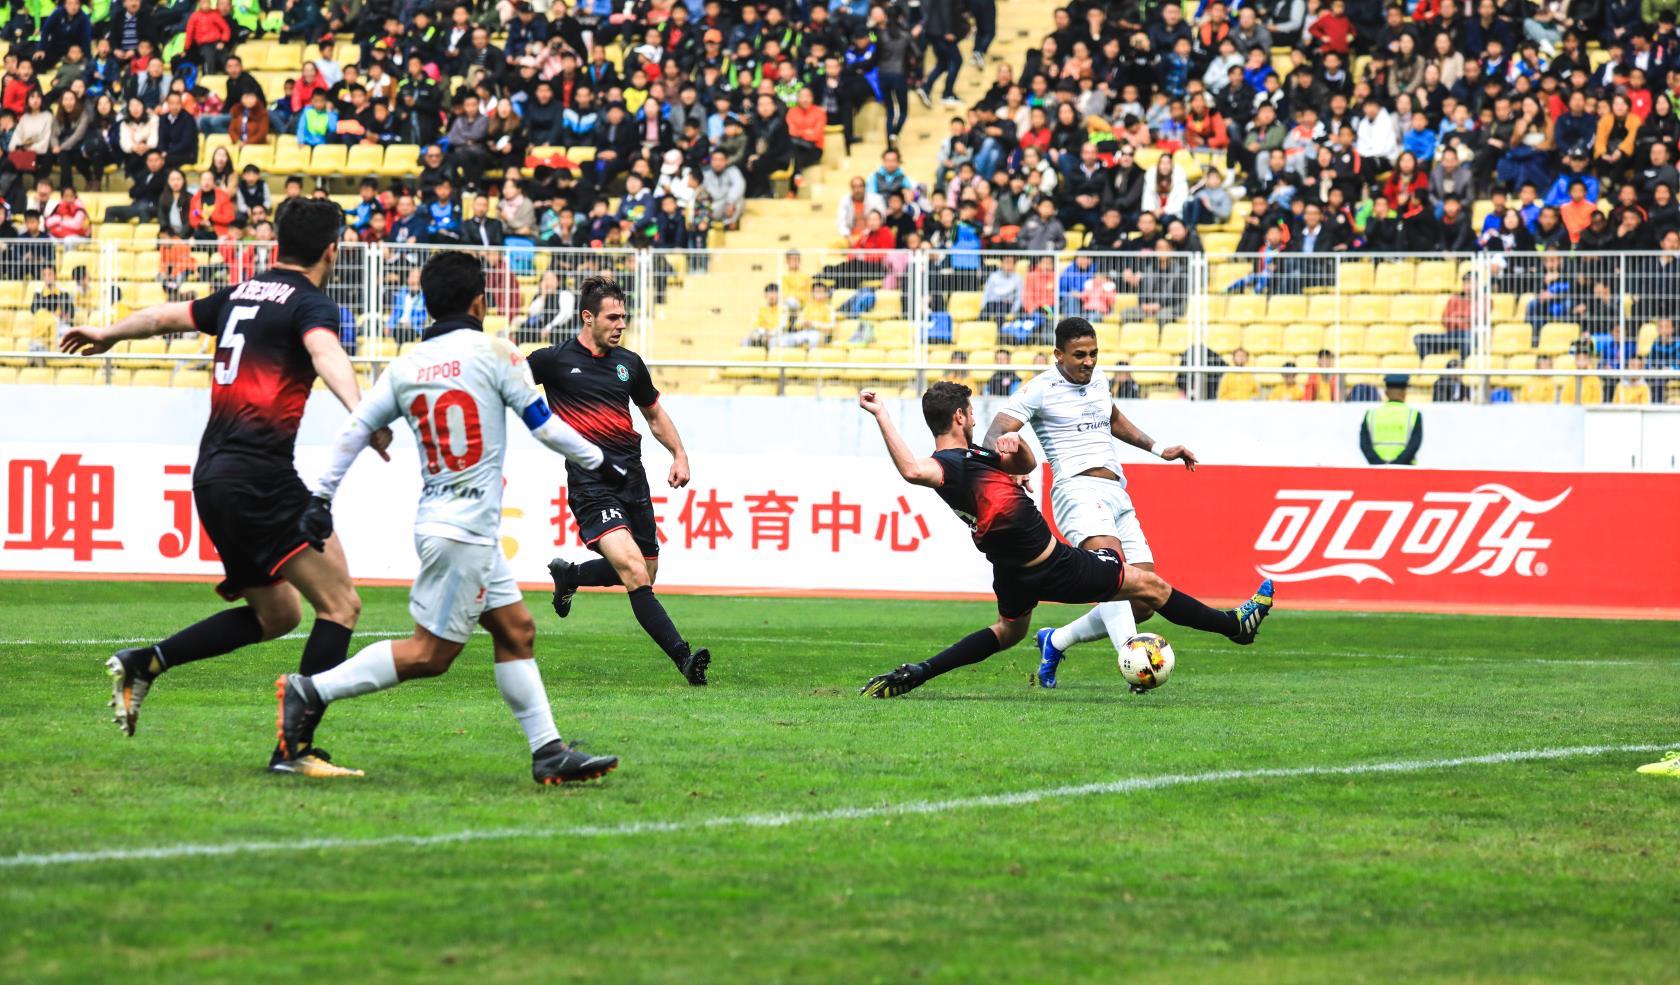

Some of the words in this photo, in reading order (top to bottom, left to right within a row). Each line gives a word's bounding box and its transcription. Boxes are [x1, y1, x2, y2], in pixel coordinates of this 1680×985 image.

[215, 305, 260, 385] 5
[416, 360, 462, 384] PIPOB
[409, 389, 484, 475] 10
[1254, 483, 1573, 585] 可口可乐
